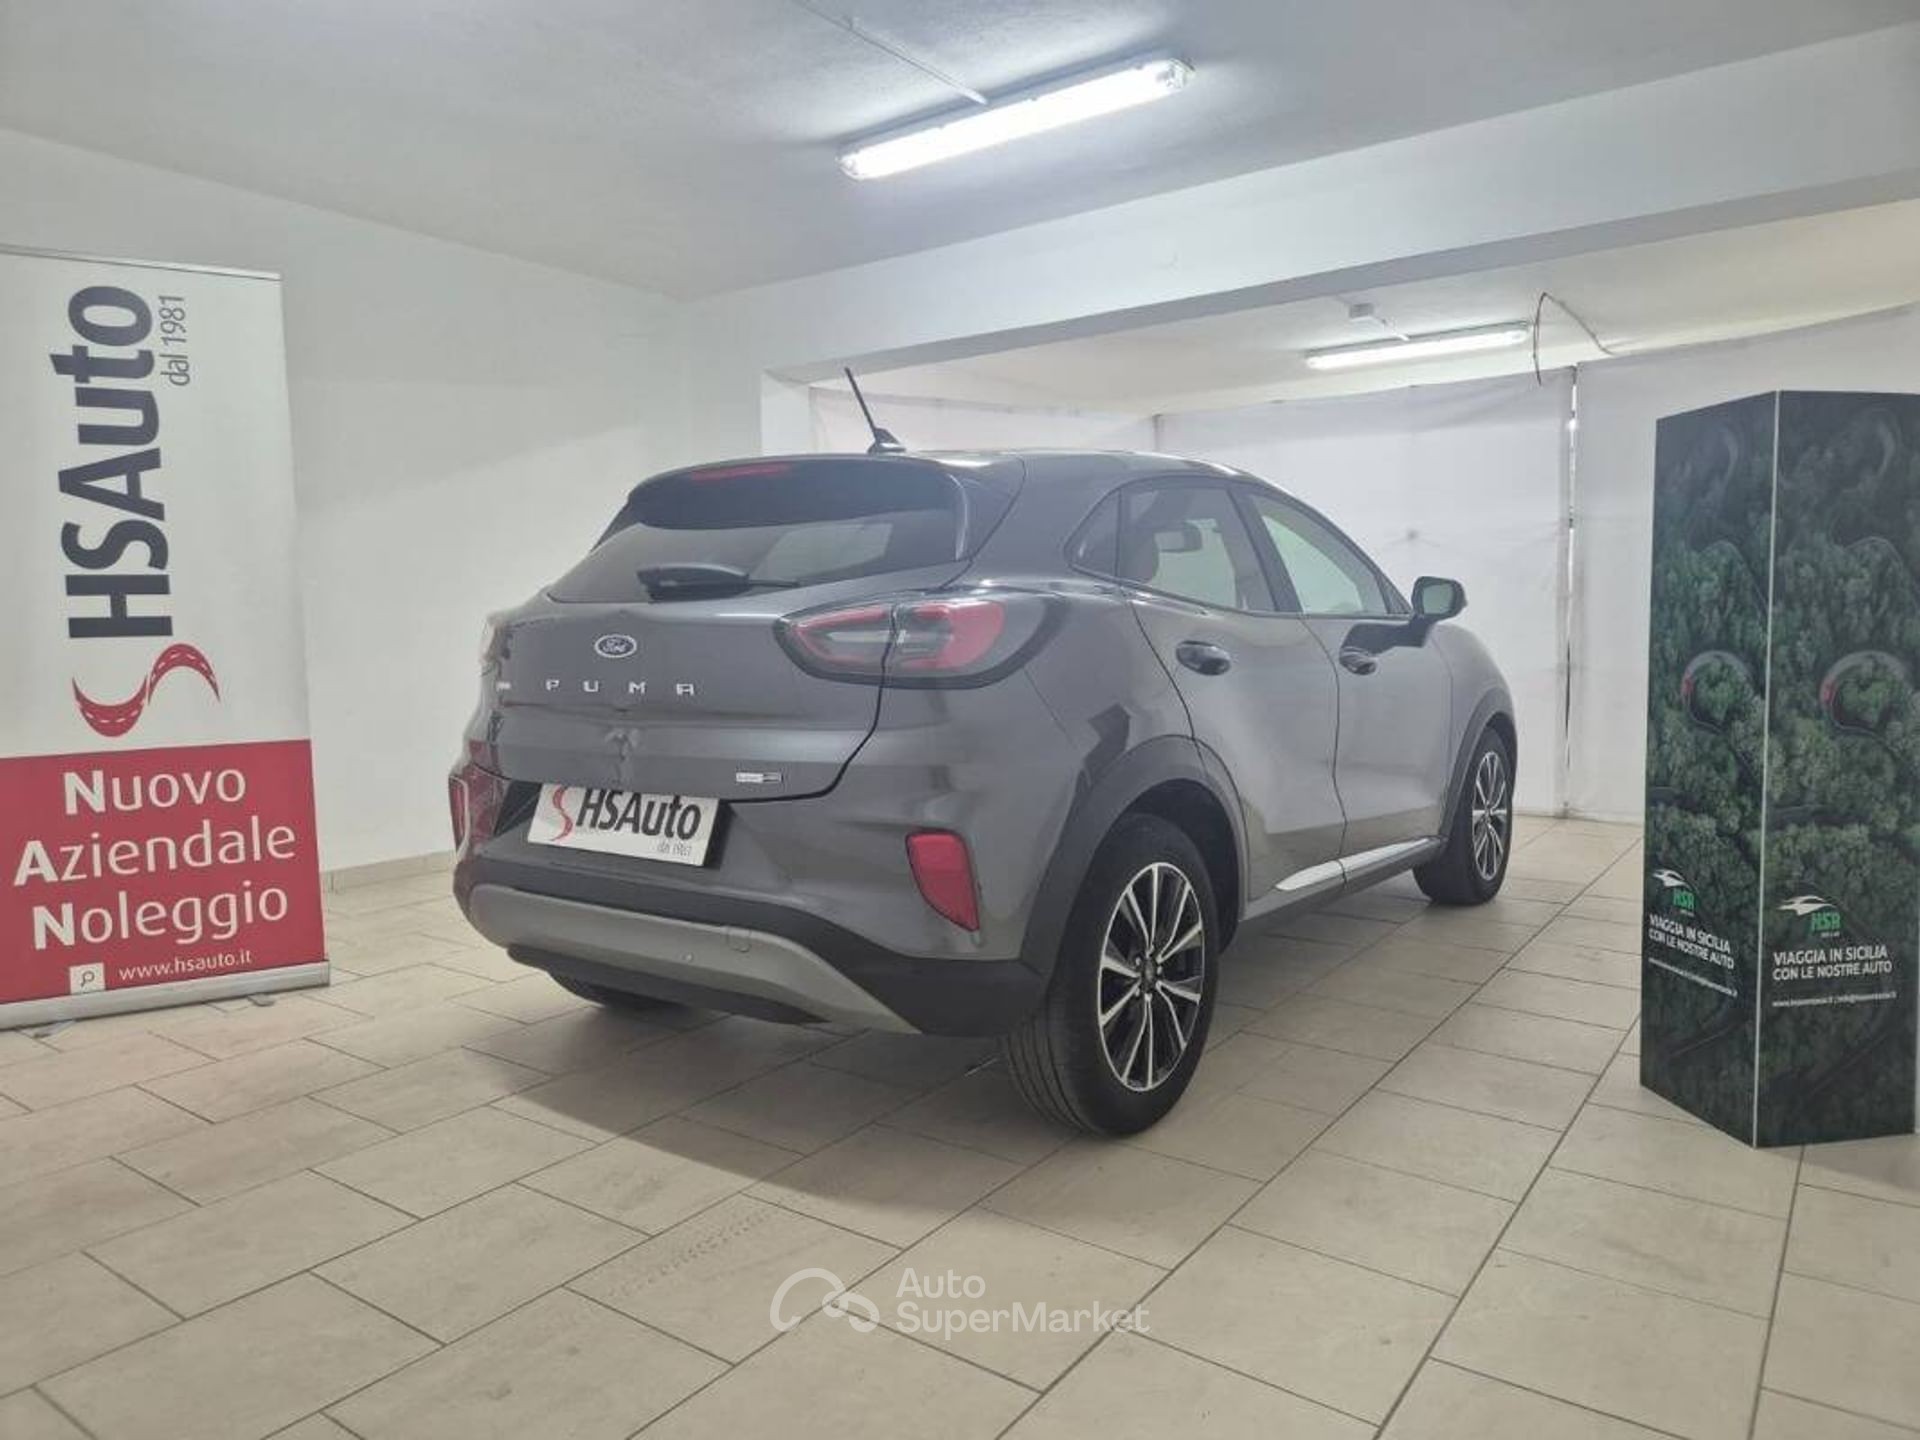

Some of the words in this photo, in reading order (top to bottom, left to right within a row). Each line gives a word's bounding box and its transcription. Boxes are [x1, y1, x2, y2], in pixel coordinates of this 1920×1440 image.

[158, 294, 186, 344] 1981
[160, 353, 190, 386] dal
[49, 286, 173, 638] HSAuto
[545, 679, 695, 696] PUMA
[63, 769, 246, 815] Nuovo
[575, 789, 702, 841] HSAuto
[13, 815, 296, 887] Aziendale
[32, 879, 288, 950] Noleggio
[119, 949, 252, 982] www.hsauto.it
[1772, 967, 1799, 981] CON
[1801, 966, 1815, 979] LE
[1817, 962, 1861, 978] NOSTRE
[1862, 959, 1893, 975] AUTO
[1773, 948, 1826, 966] VIAGGIA
[1829, 947, 1843, 962] IN
[1846, 943, 1889, 960] SICILIA
